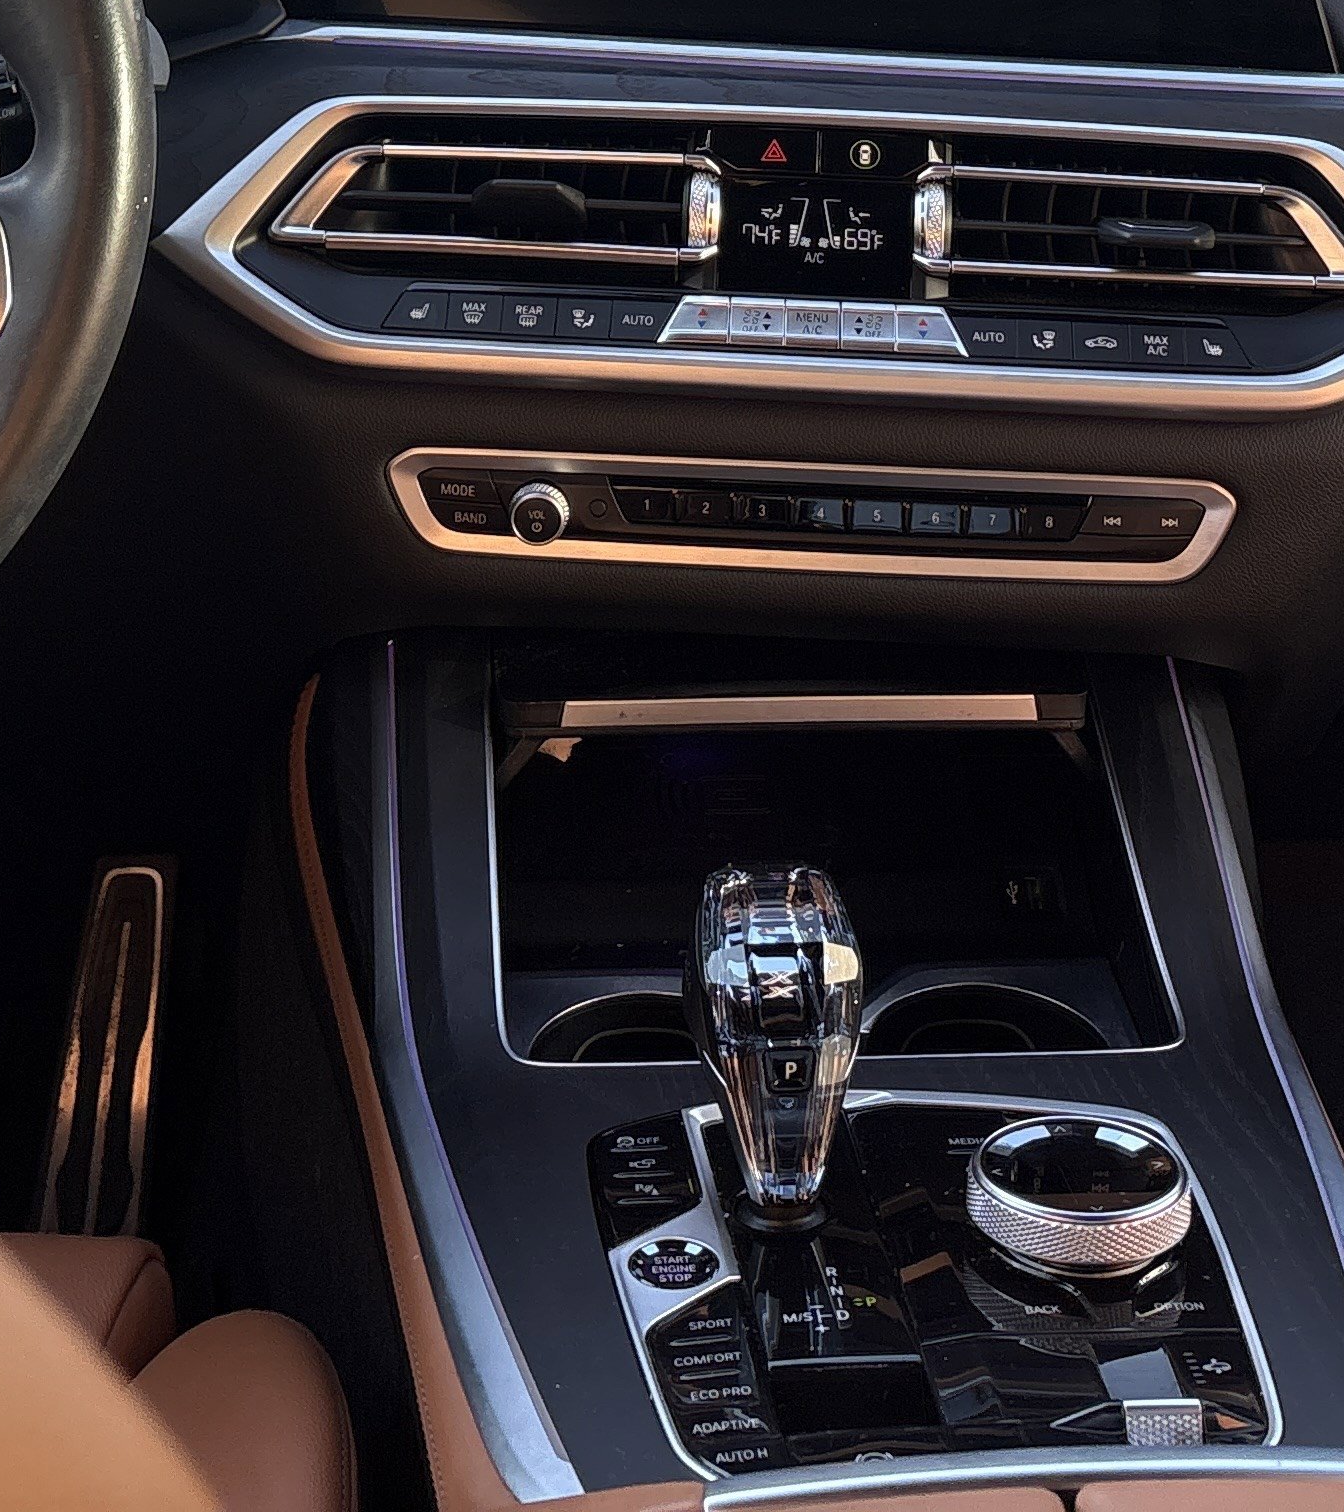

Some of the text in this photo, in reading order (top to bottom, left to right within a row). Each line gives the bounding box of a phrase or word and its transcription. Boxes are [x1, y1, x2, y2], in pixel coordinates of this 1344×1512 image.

[803, 252, 825, 264] A/C
[462, 302, 487, 312] MAX
[514, 304, 544, 316] REAR
[621, 314, 654, 326] AUTO
[795, 312, 829, 323] MENU
[972, 331, 1005, 343] AUTO
[1143, 335, 1169, 345] MAX
[1147, 345, 1168, 356] A/C
[440, 483, 476, 498] MODE
[643, 499, 651, 511] 1
[702, 501, 711, 515] 2
[758, 504, 767, 517] 3
[454, 511, 487, 525] BAND
[528, 509, 546, 520] VOL
[816, 506, 825, 519] 4
[873, 509, 882, 522] 5
[932, 511, 941, 524] 6
[989, 513, 997, 526] 7
[1045, 515, 1054, 529] 8
[785, 1061, 797, 1080] P
[636, 1137, 660, 1145] OFF
[654, 1255, 691, 1264] START
[651, 1264, 697, 1274] ENGINE
[825, 1266, 838, 1277] R
[659, 1273, 693, 1283] STOP
[830, 1285, 844, 1296] N
[1024, 1304, 1062, 1315] BACK
[1153, 1301, 1205, 1312] OPTION
[836, 1309, 850, 1321] D
[688, 1317, 733, 1331] SPORT
[673, 1351, 742, 1367] COMFORT
[690, 1385, 752, 1401] ECO PRO
[692, 1417, 759, 1435] ADAPTIVE
[715, 1447, 769, 1464] AUTO H
